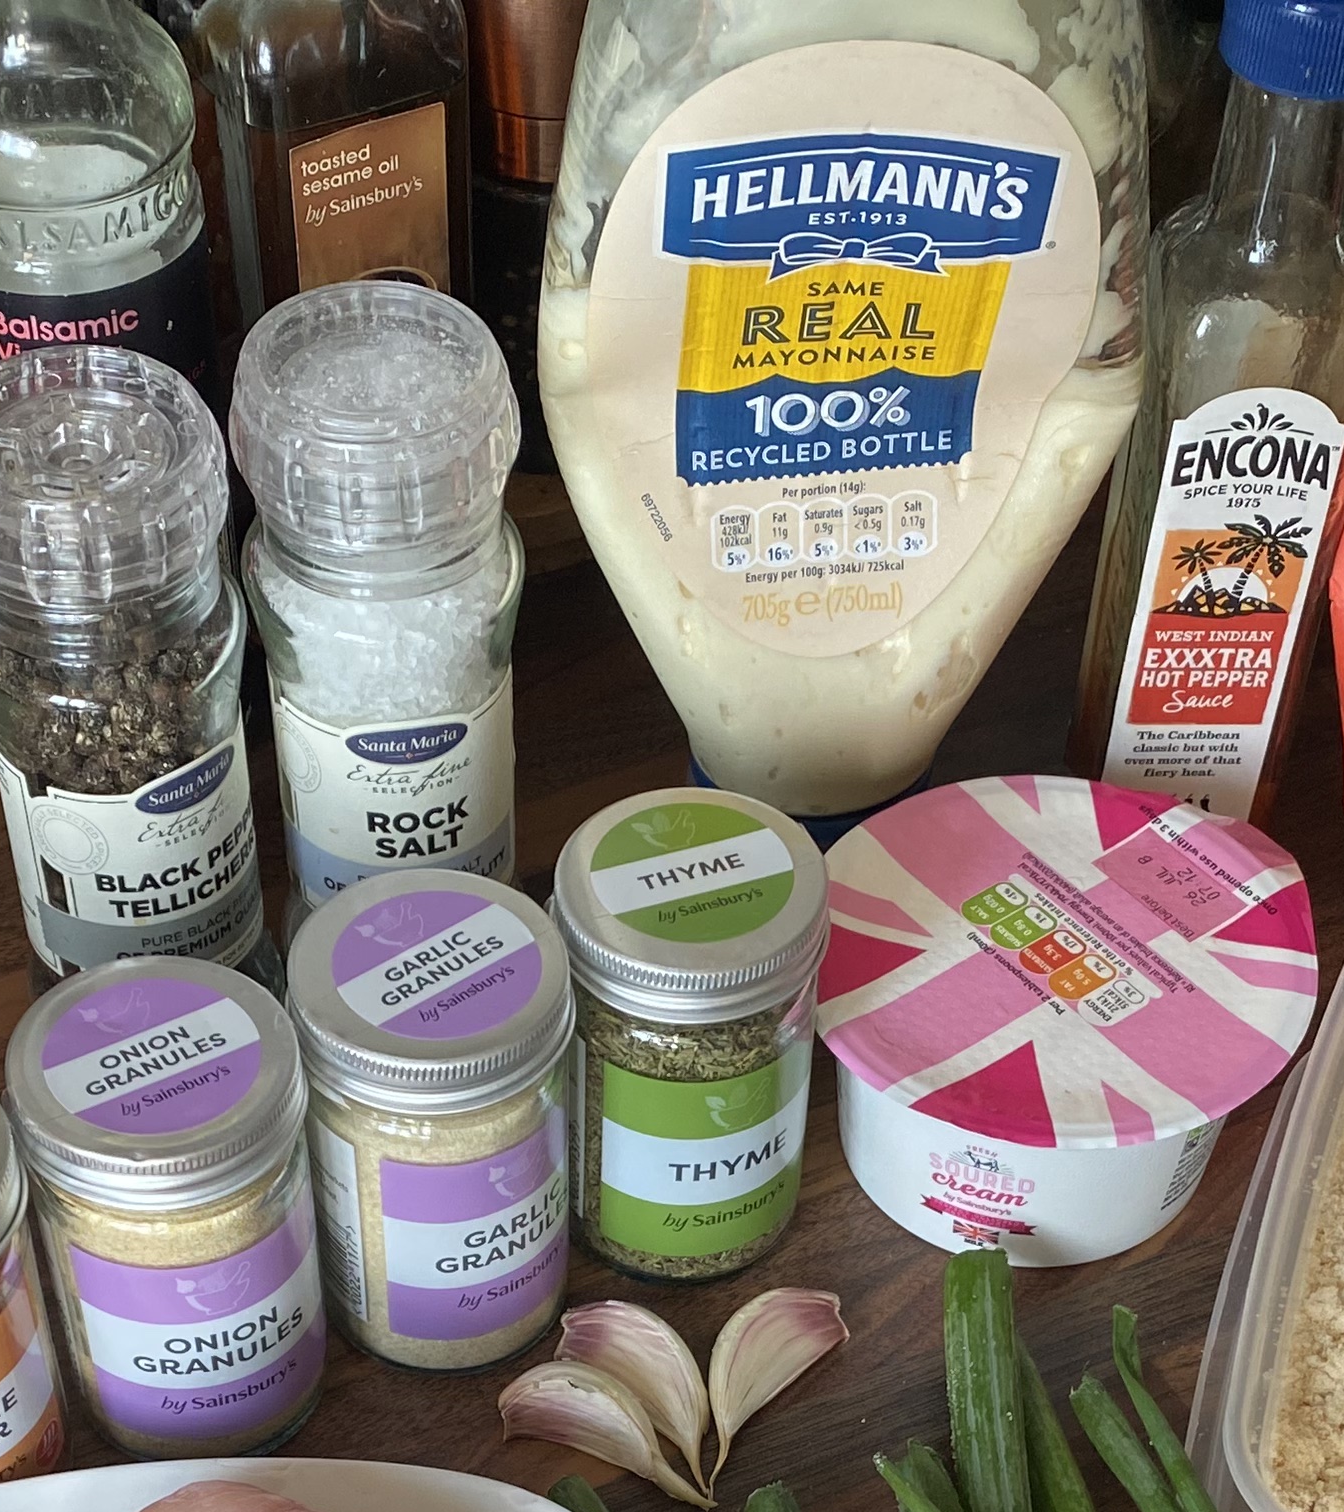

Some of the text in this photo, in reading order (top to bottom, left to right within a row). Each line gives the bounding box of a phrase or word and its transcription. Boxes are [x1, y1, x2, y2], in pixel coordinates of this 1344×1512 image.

[301, 143, 370, 176] toasted
[302, 154, 399, 197] sesame oil
[305, 176, 423, 227] by Sainsbury's
[691, 159, 1030, 224] HELLMANN'S
[807, 279, 885, 298] SAME
[742, 300, 935, 346] REAL
[732, 344, 937, 369] MAYONNAISE
[745, 385, 912, 439] 100%
[692, 429, 953, 471] RECYCLED BOTTLE
[1171, 435, 1332, 490] ENCONA
[782, 481, 866, 500] Per portion (14g):
[904, 501, 922, 512] Salt
[1183, 484, 1308, 501] SPICE YOUR LIFE
[1226, 497, 1260, 508] 1975
[640, 493, 673, 542] 69722056
[719, 512, 751, 527] Energy
[772, 512, 787, 523] Fat
[804, 507, 843, 520] Saturates
[814, 522, 833, 535] 0.9g
[852, 504, 883, 517] Sugars
[900, 516, 925, 529] 0.17g
[745, 570, 778, 583] Energy
[781, 569, 797, 581] per
[799, 566, 826, 579] 100g:
[867, 559, 904, 572] 725kcal
[741, 580, 904, 627] 705g (750ml)
[1155, 630, 1274, 643] WEST INDIAN
[1144, 648, 1273, 669] EXXXTRA
[1140, 670, 1270, 688] HOT PEPPER
[1163, 690, 1234, 714] Sauce
[358, 728, 457, 753] Santa Maria
[1133, 743, 1239, 753] classic but with
[1137, 730, 1240, 741] The Caribbean
[148, 752, 229, 807] Santa Maria
[347, 757, 472, 797] Extra fine
[1143, 767, 1216, 779] fiery heat.
[1195, 755, 1210, 765] of
[1213, 756, 1242, 766] that
[366, 795, 469, 834] ROCK
[95, 801, 255, 893] BLACK PEPP
[376, 825, 463, 859] SALT
[1138, 805, 1278, 916] Once opened use within 3 days
[109, 826, 256, 918] TELLICHERR
[637, 853, 745, 890] THYME
[658, 887, 763, 924] by Sainsbury's
[1034, 892, 1104, 949] Reference Intakes
[1141, 895, 1195, 938] Best before
[995, 924, 1023, 947] SUGARS
[381, 935, 504, 1006] GRANULES
[384, 931, 471, 982] GARLIC
[994, 952, 1048, 999] tablespoons
[419, 966, 515, 1023] by Sainsbury's
[1048, 1000, 1066, 1016] Per
[1083, 998, 1112, 1022] ENERGY
[86, 1032, 226, 1096] GRANULES
[99, 1026, 190, 1069] ONION
[120, 1064, 232, 1117] by Sainsbury's
[668, 1128, 788, 1182] THYME
[929, 1152, 1035, 1193] SOURED
[662, 1182, 786, 1231] by Sainsbury's
[931, 1172, 1028, 1207] cream
[463, 1177, 561, 1248] GARLIC
[133, 1306, 303, 1375] GRANULES
[164, 1306, 278, 1354] ONION
[161, 1358, 297, 1415] by Sainsbury's
